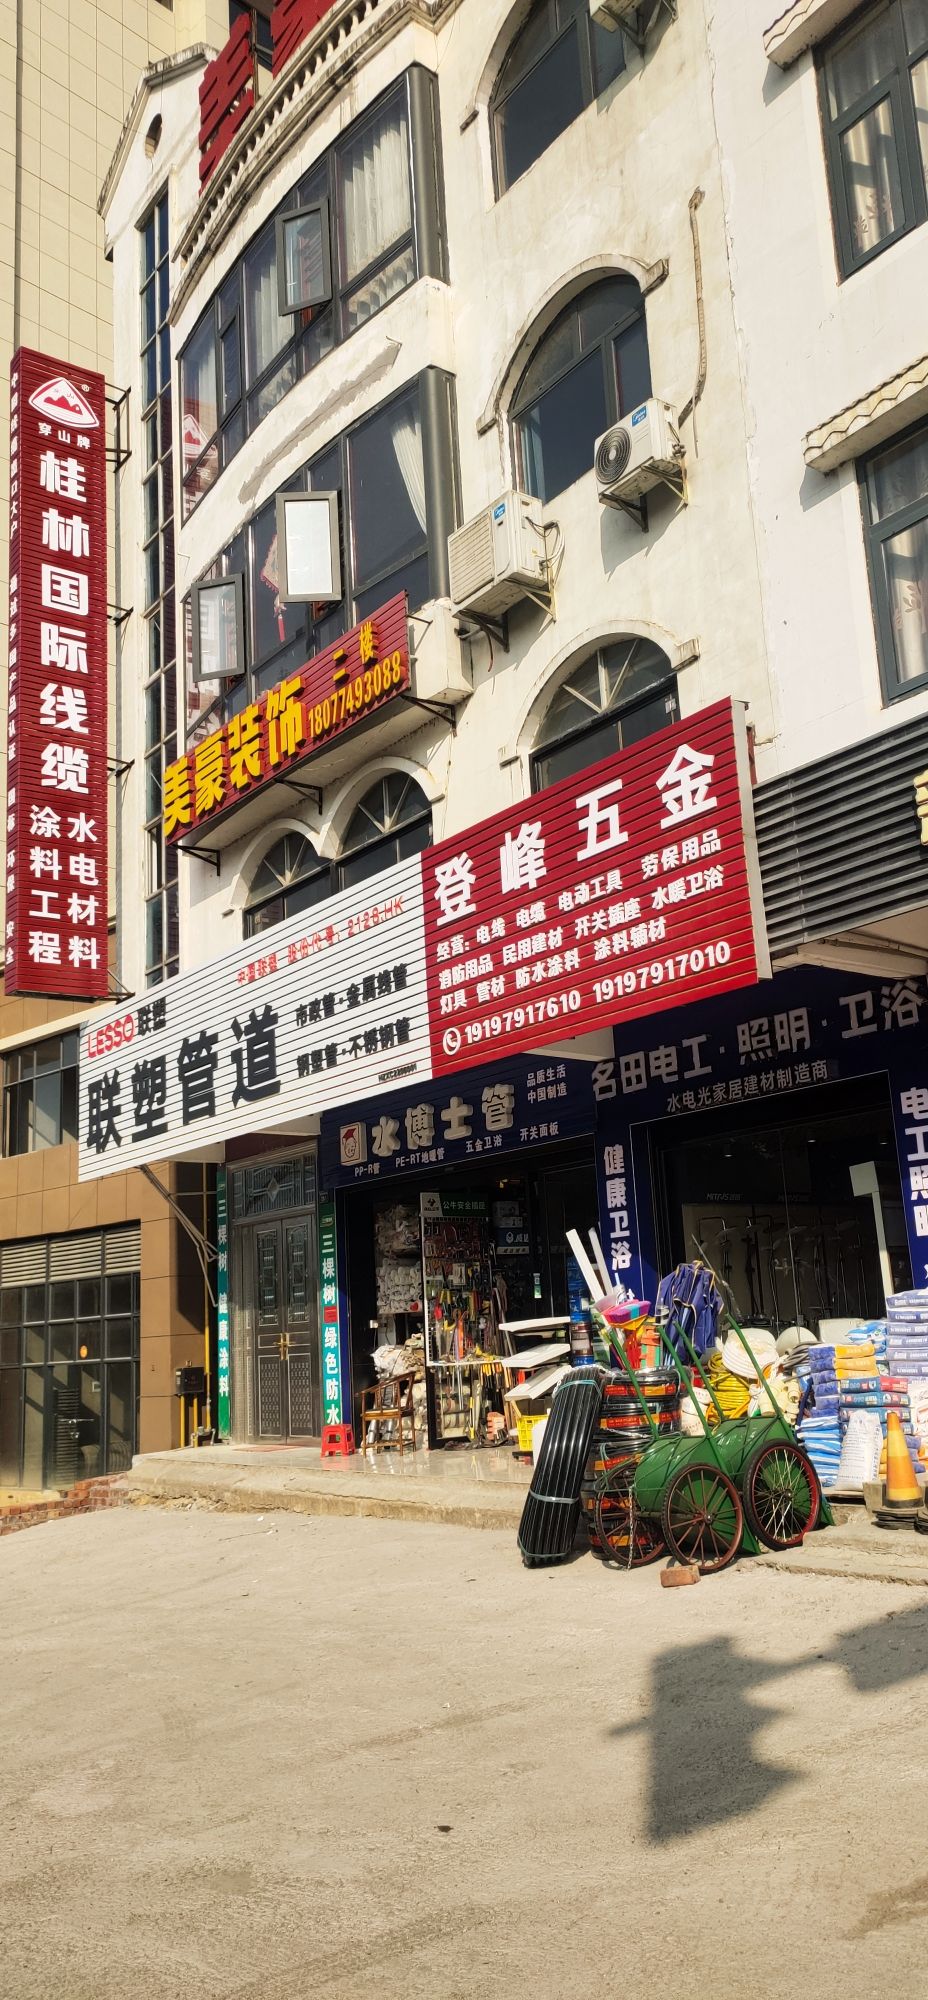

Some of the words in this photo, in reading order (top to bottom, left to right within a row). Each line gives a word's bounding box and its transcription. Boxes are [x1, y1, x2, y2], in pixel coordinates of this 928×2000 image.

[38, 422, 91, 450] 穿山牌
[40, 450, 90, 794] 桂林国际线缆
[332, 620, 376, 682] 二楼
[308, 651, 401, 738] 18077493088
[164, 675, 306, 837] 美豪装饰
[434, 743, 718, 927] 登峰五金
[29, 804, 62, 965] 涂料工程
[67, 812, 101, 969] 水电材料
[438, 953, 494, 990] 消防用品
[502, 927, 563, 966] 民用建材
[574, 898, 641, 939] 开关插座
[651, 864, 725, 910] 水暖卫浴
[476, 918, 506, 945] 电线
[515, 901, 547, 929] 电缆
[558, 869, 623, 912] 电动工具
[641, 828, 722, 879] 劳保用品
[6, 921, 15, 965] 安全
[440, 990, 467, 1016] 灯具
[476, 976, 506, 1003] 管材
[515, 948, 581, 989] 防水涂料
[594, 918, 667, 961] 涂料辅材
[87, 1013, 135, 1059] LESSO
[137, 997, 167, 1036] 联塑
[465, 990, 581, 1044] 19197917610
[593, 941, 731, 1003] 19197917010
[87, 1004, 282, 1154] 联塑管道
[371, 1084, 515, 1157] 水博士管
[526, 1064, 566, 1087] 品质生活
[527, 1082, 568, 1104] 中国制造
[666, 1060, 829, 1113] 水电光家居建材制造商
[354, 1162, 380, 1177] PP-R管
[395, 1148, 445, 1168] PE-RT地暖管
[465, 1135, 503, 1153] 五金卫浴
[519, 1122, 559, 1142] 开关面板
[218, 1200, 227, 1272] 三棵树
[604, 1143, 632, 1271] 健康卫浴
[322, 1234, 336, 1305] 三棵树
[218, 1293, 229, 1397] 健康涂料
[324, 1327, 340, 1425] 绿色防水
